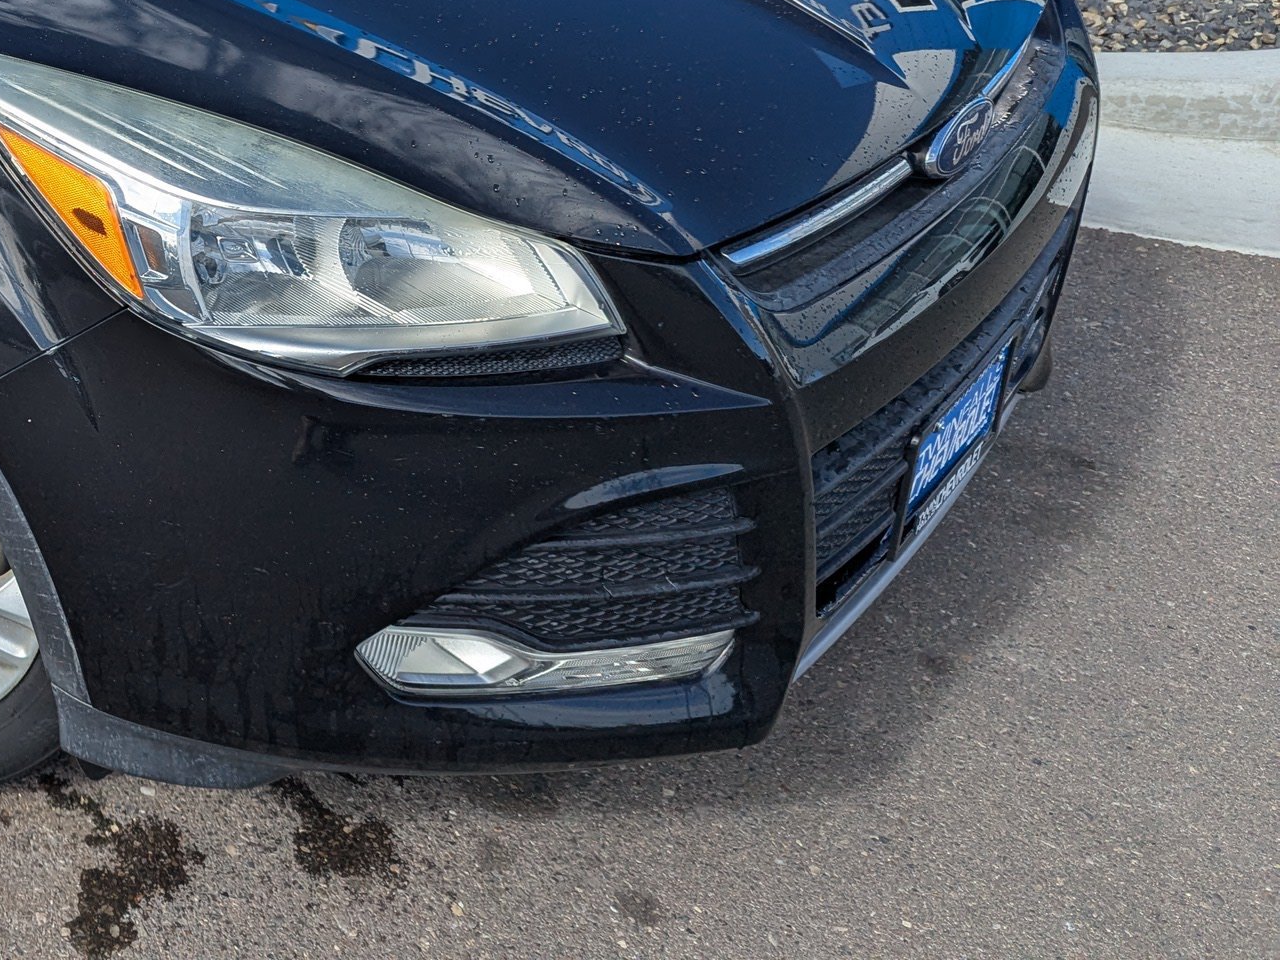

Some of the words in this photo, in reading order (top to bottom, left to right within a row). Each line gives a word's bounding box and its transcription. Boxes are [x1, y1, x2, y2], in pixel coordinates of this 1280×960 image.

[953, 112, 989, 166] Ford
[908, 379, 1000, 504] CHEVROLET
[937, 441, 985, 506] CHEVROLET
